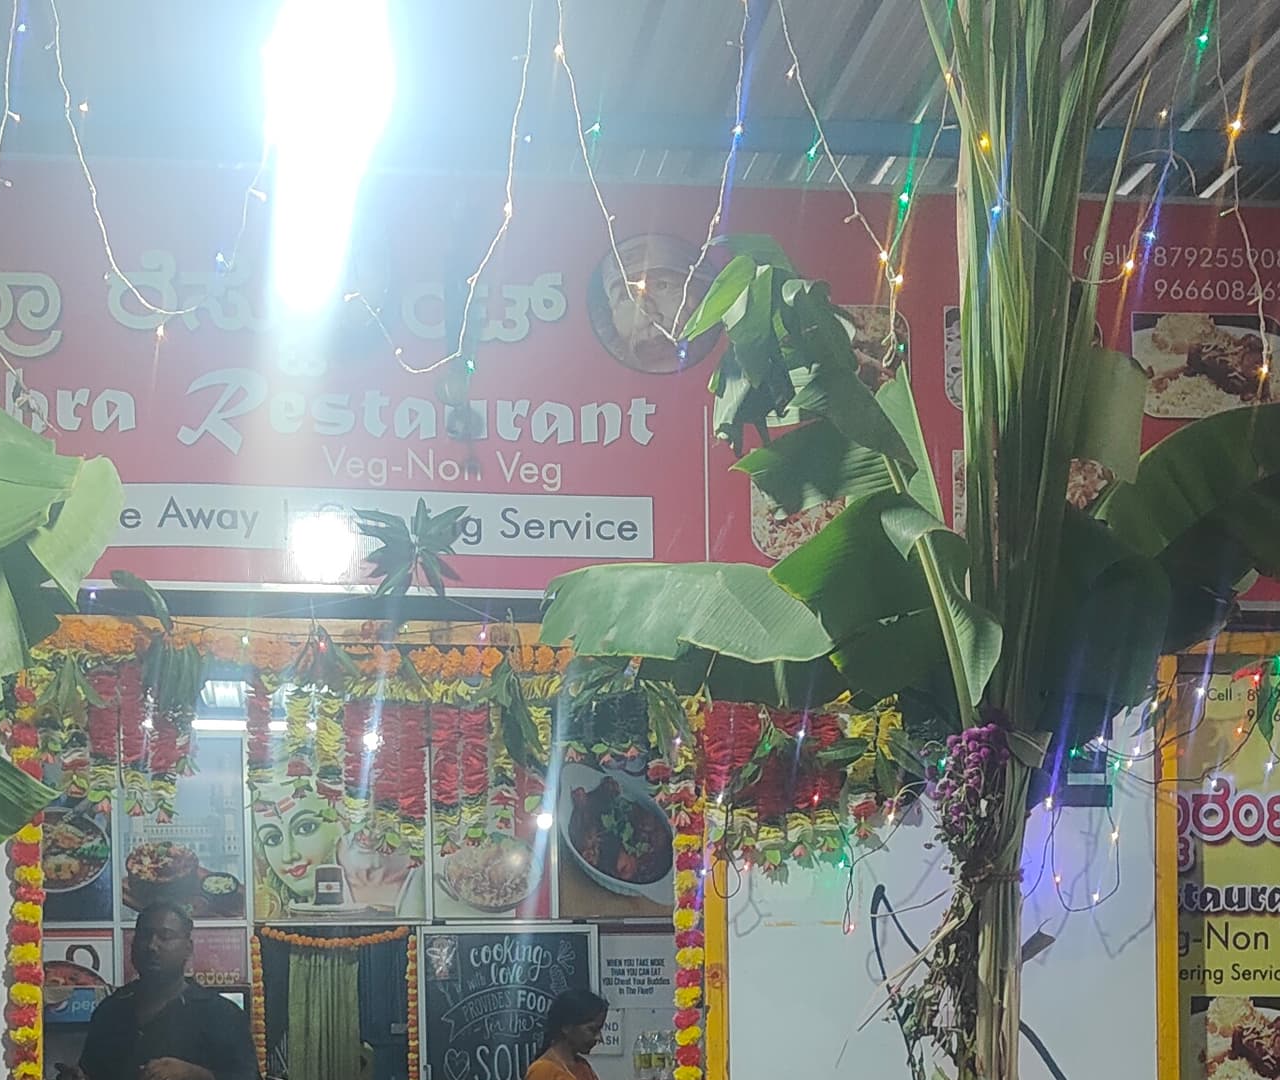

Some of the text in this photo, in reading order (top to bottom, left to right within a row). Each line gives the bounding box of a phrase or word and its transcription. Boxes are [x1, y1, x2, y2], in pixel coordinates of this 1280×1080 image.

[176, 367, 657, 456] Restaurant
[321, 446, 562, 491] Veg-Non Veg
[157, 496, 259, 539] Away
[499, 507, 639, 542] Service
[1206, 687, 1233, 701] Cell
[1178, 920, 1269, 958] g-Non
[470, 935, 551, 982] cooking
[489, 963, 529, 985] love
[1178, 964, 1224, 985] ering
[462, 990, 512, 1022] PROVIDES
[604, 1022, 619, 1032] ND
